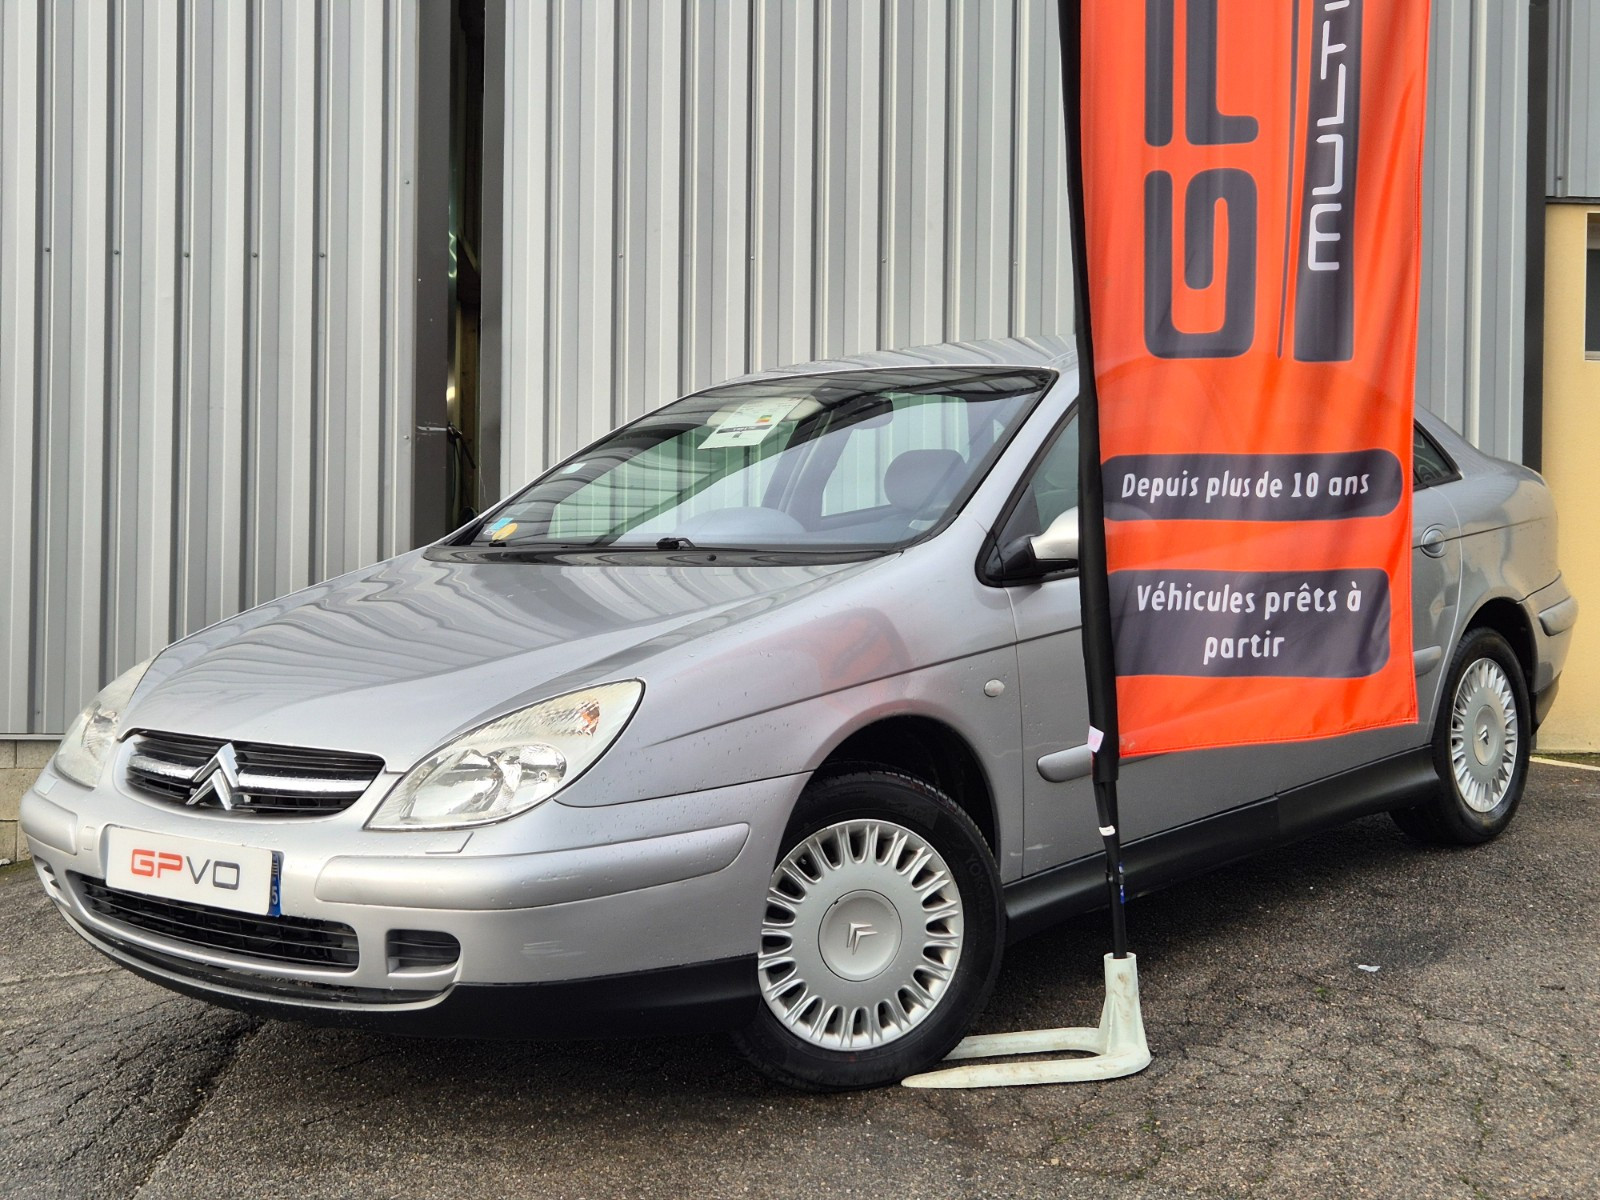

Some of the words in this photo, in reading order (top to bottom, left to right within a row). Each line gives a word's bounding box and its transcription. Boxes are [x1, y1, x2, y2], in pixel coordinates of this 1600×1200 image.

[1121, 470, 1200, 504] Depuis
[1205, 469, 1251, 504] plus
[1255, 470, 1283, 498] de
[1291, 472, 1320, 498] 10
[1328, 472, 1371, 497] ans
[1137, 580, 1256, 614] Véhicules
[1264, 582, 1339, 620] prêts
[1346, 580, 1363, 613] à
[1203, 630, 1286, 666] partir
[131, 848, 241, 891] GPVO
